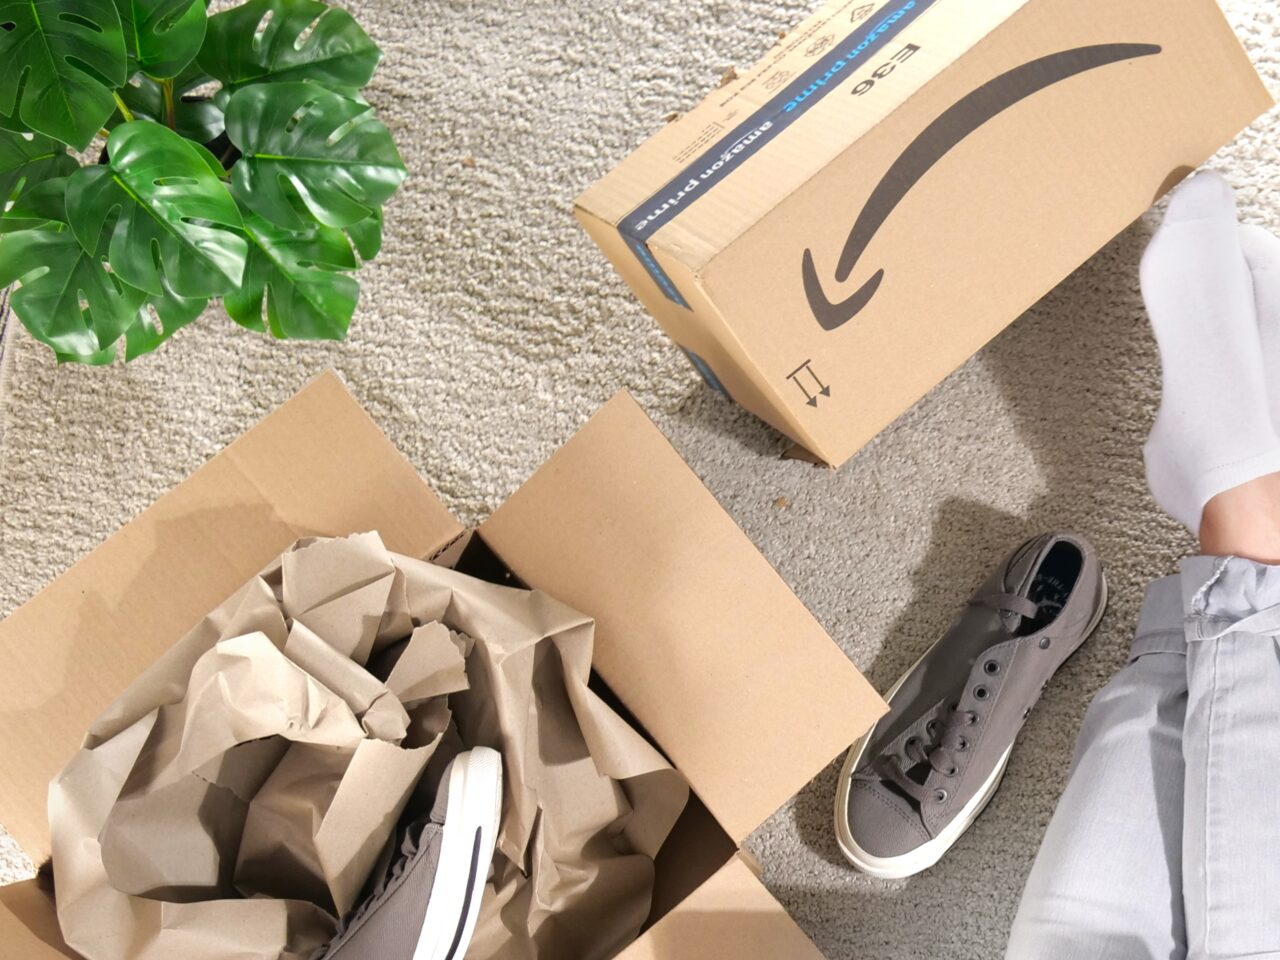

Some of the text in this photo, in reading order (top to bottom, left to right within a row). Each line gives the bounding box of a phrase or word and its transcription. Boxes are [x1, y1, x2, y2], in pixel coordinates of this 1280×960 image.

[846, 0, 916, 59] amazon
[783, 60, 849, 112] prime
[850, 43, 921, 97] E36
[700, 120, 773, 180] amazon
[634, 178, 700, 231] prime
